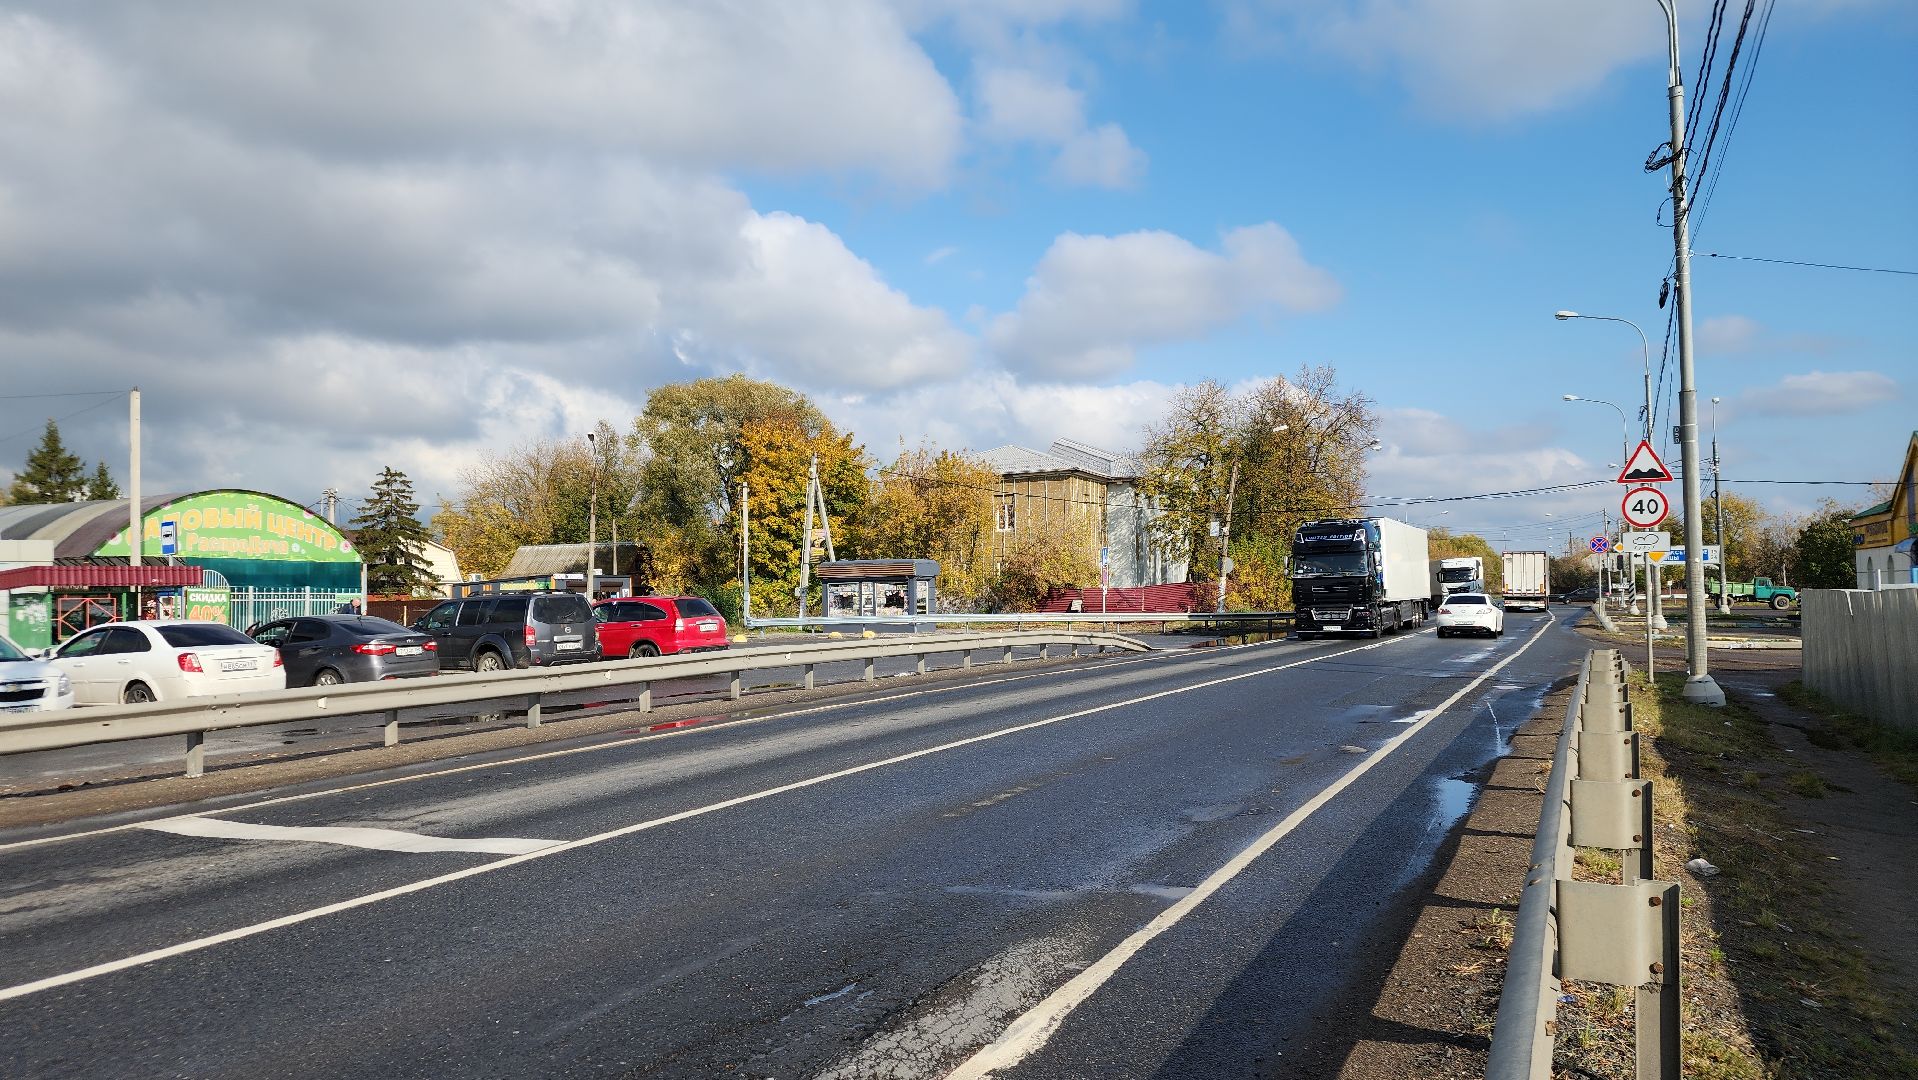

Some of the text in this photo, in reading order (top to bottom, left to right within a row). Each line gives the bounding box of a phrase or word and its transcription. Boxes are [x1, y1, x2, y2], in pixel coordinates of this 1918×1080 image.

[1632, 499, 1658, 514] 40
[267, 512, 337, 551] ЦЕНТР
[189, 593, 227, 603] СКИДКА
[189, 604, 227, 624] 40%
